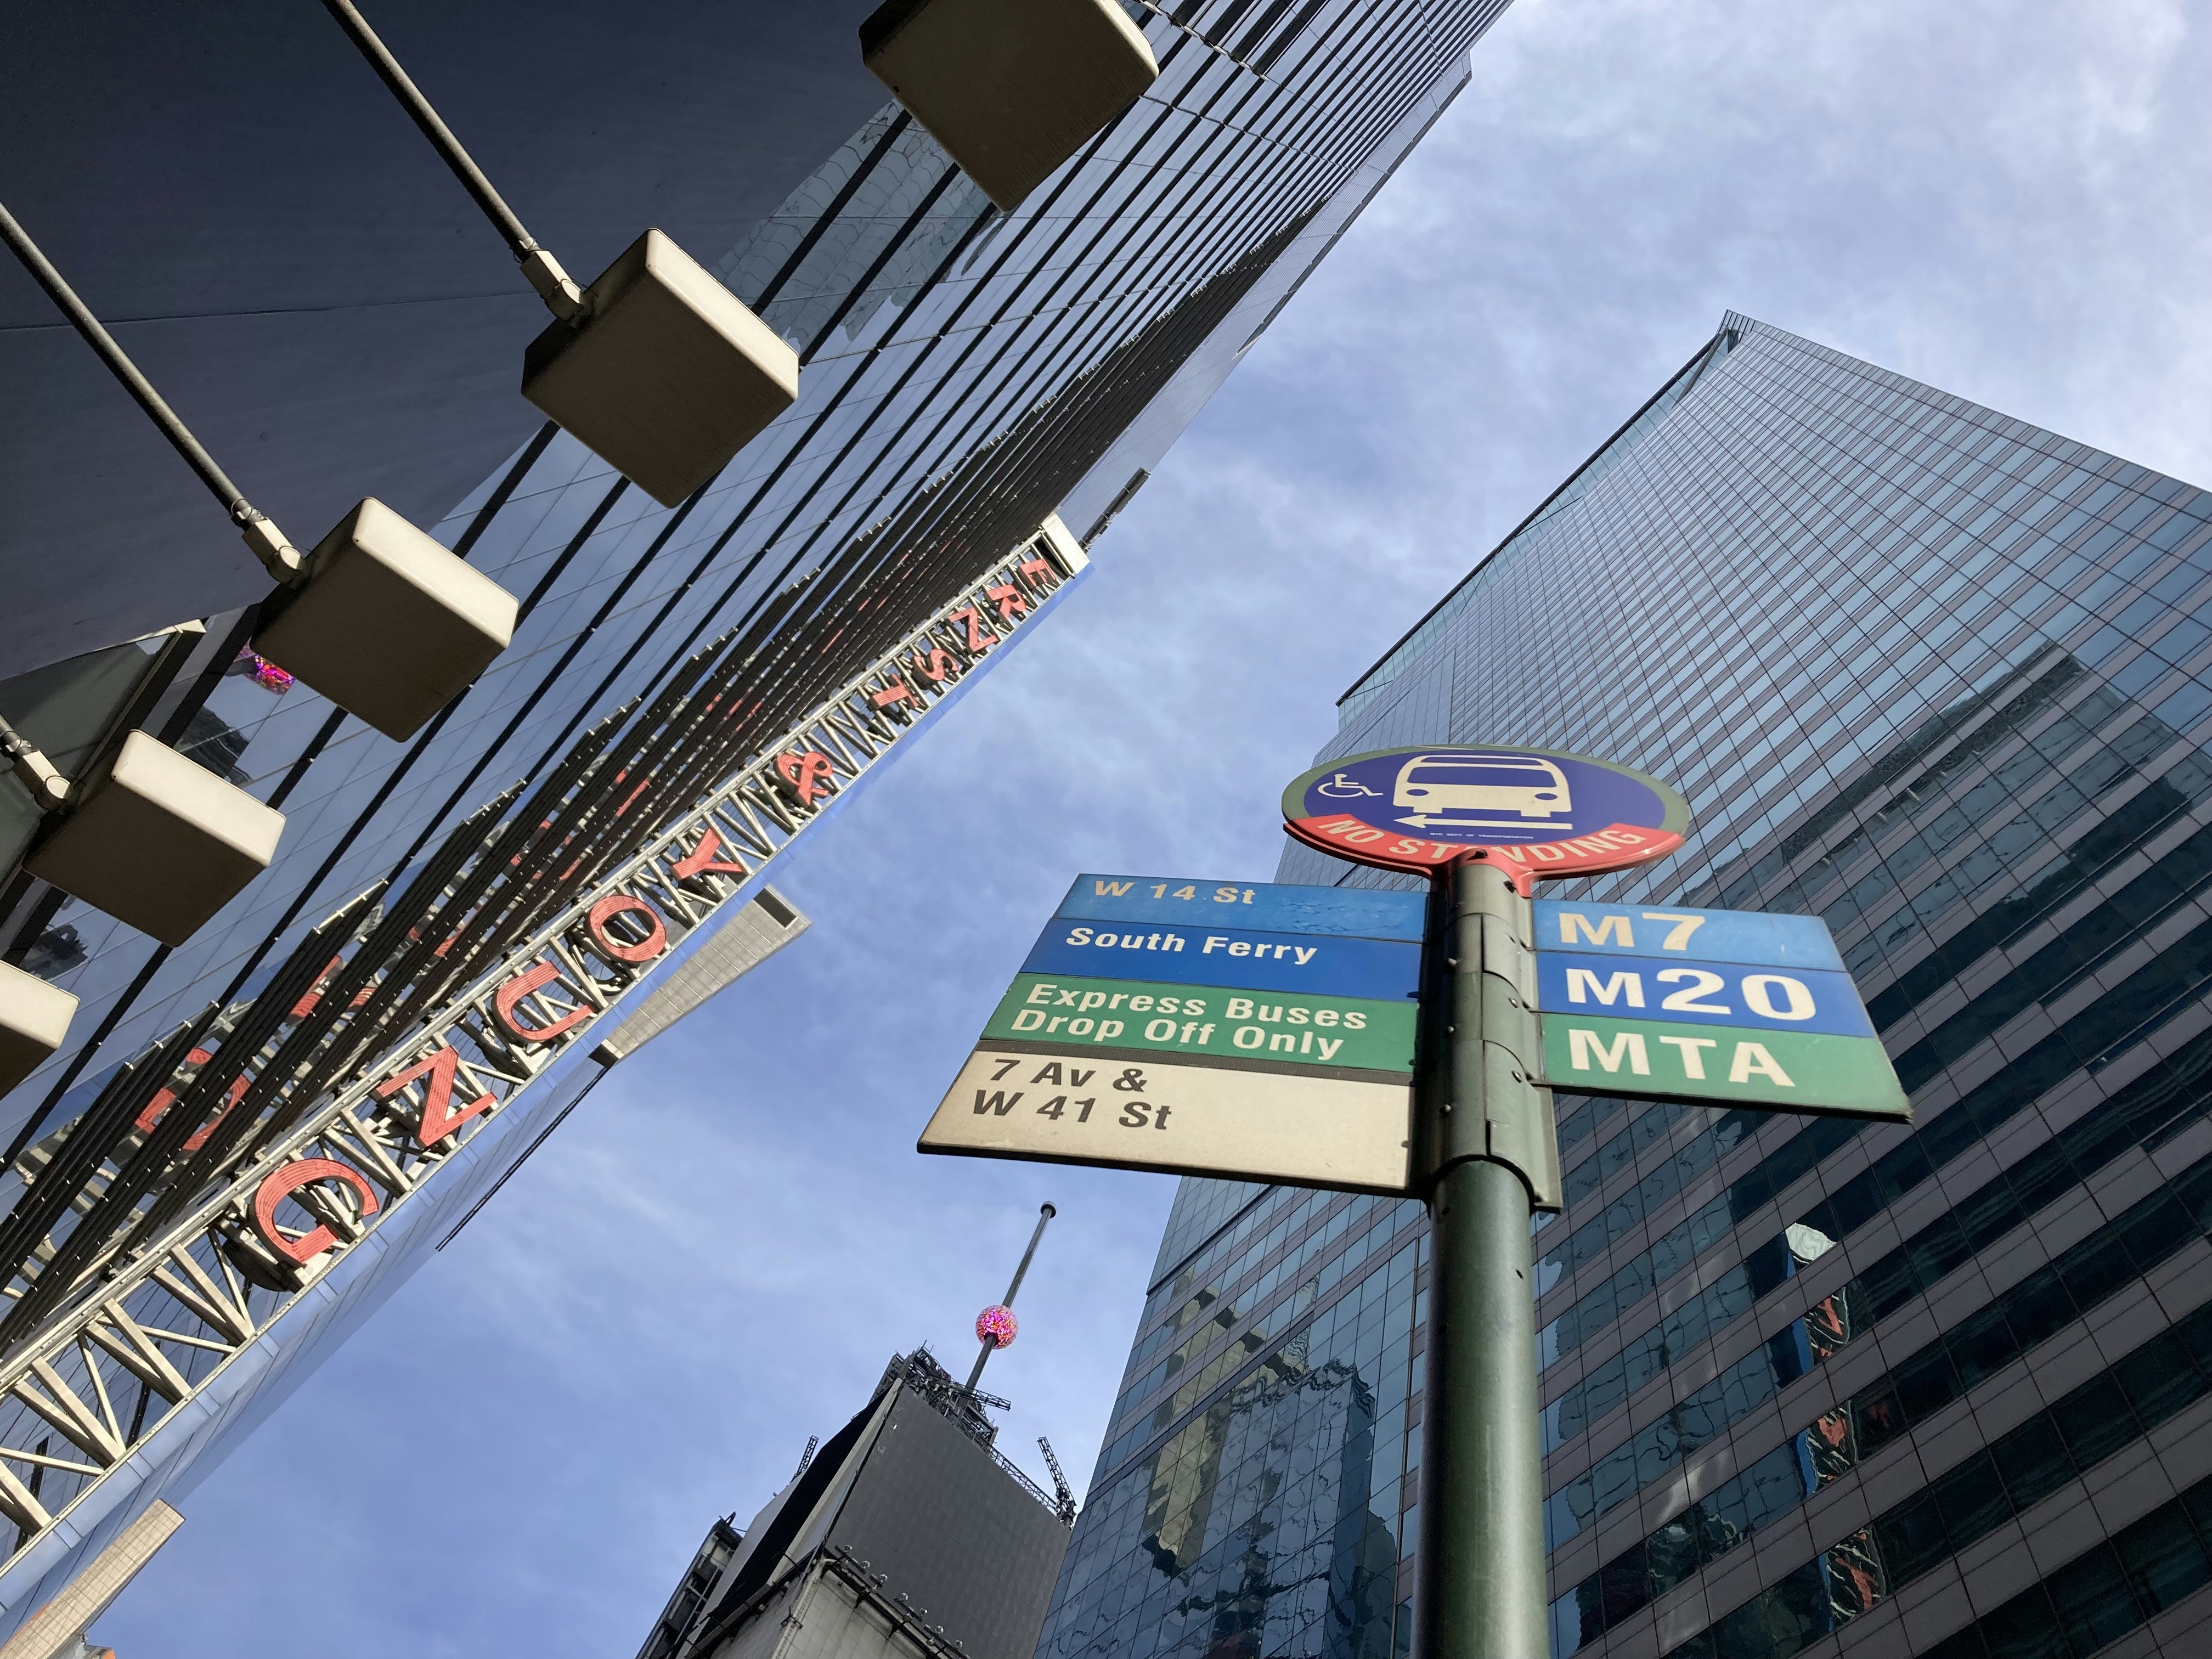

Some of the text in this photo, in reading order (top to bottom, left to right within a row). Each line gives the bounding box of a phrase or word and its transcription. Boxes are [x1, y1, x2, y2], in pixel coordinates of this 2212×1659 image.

[872, 558, 1057, 709] ERNST
[776, 751, 833, 806] &
[1318, 820, 1647, 862] NO STNDING
[1094, 881, 1256, 905] W 14 St
[1065, 927, 1317, 966] South Ferry
[1559, 912, 1706, 951] M7
[1027, 983, 1367, 1030] Express Buses
[1566, 968, 1816, 1021] M20
[252, 827, 746, 1266] YOUNG
[1010, 1009, 1345, 1060] Drop Off Only
[1568, 1028, 1796, 1087] MTA
[989, 1059, 1148, 1093] 7 Av &
[972, 1090, 1172, 1130] W 41 St
